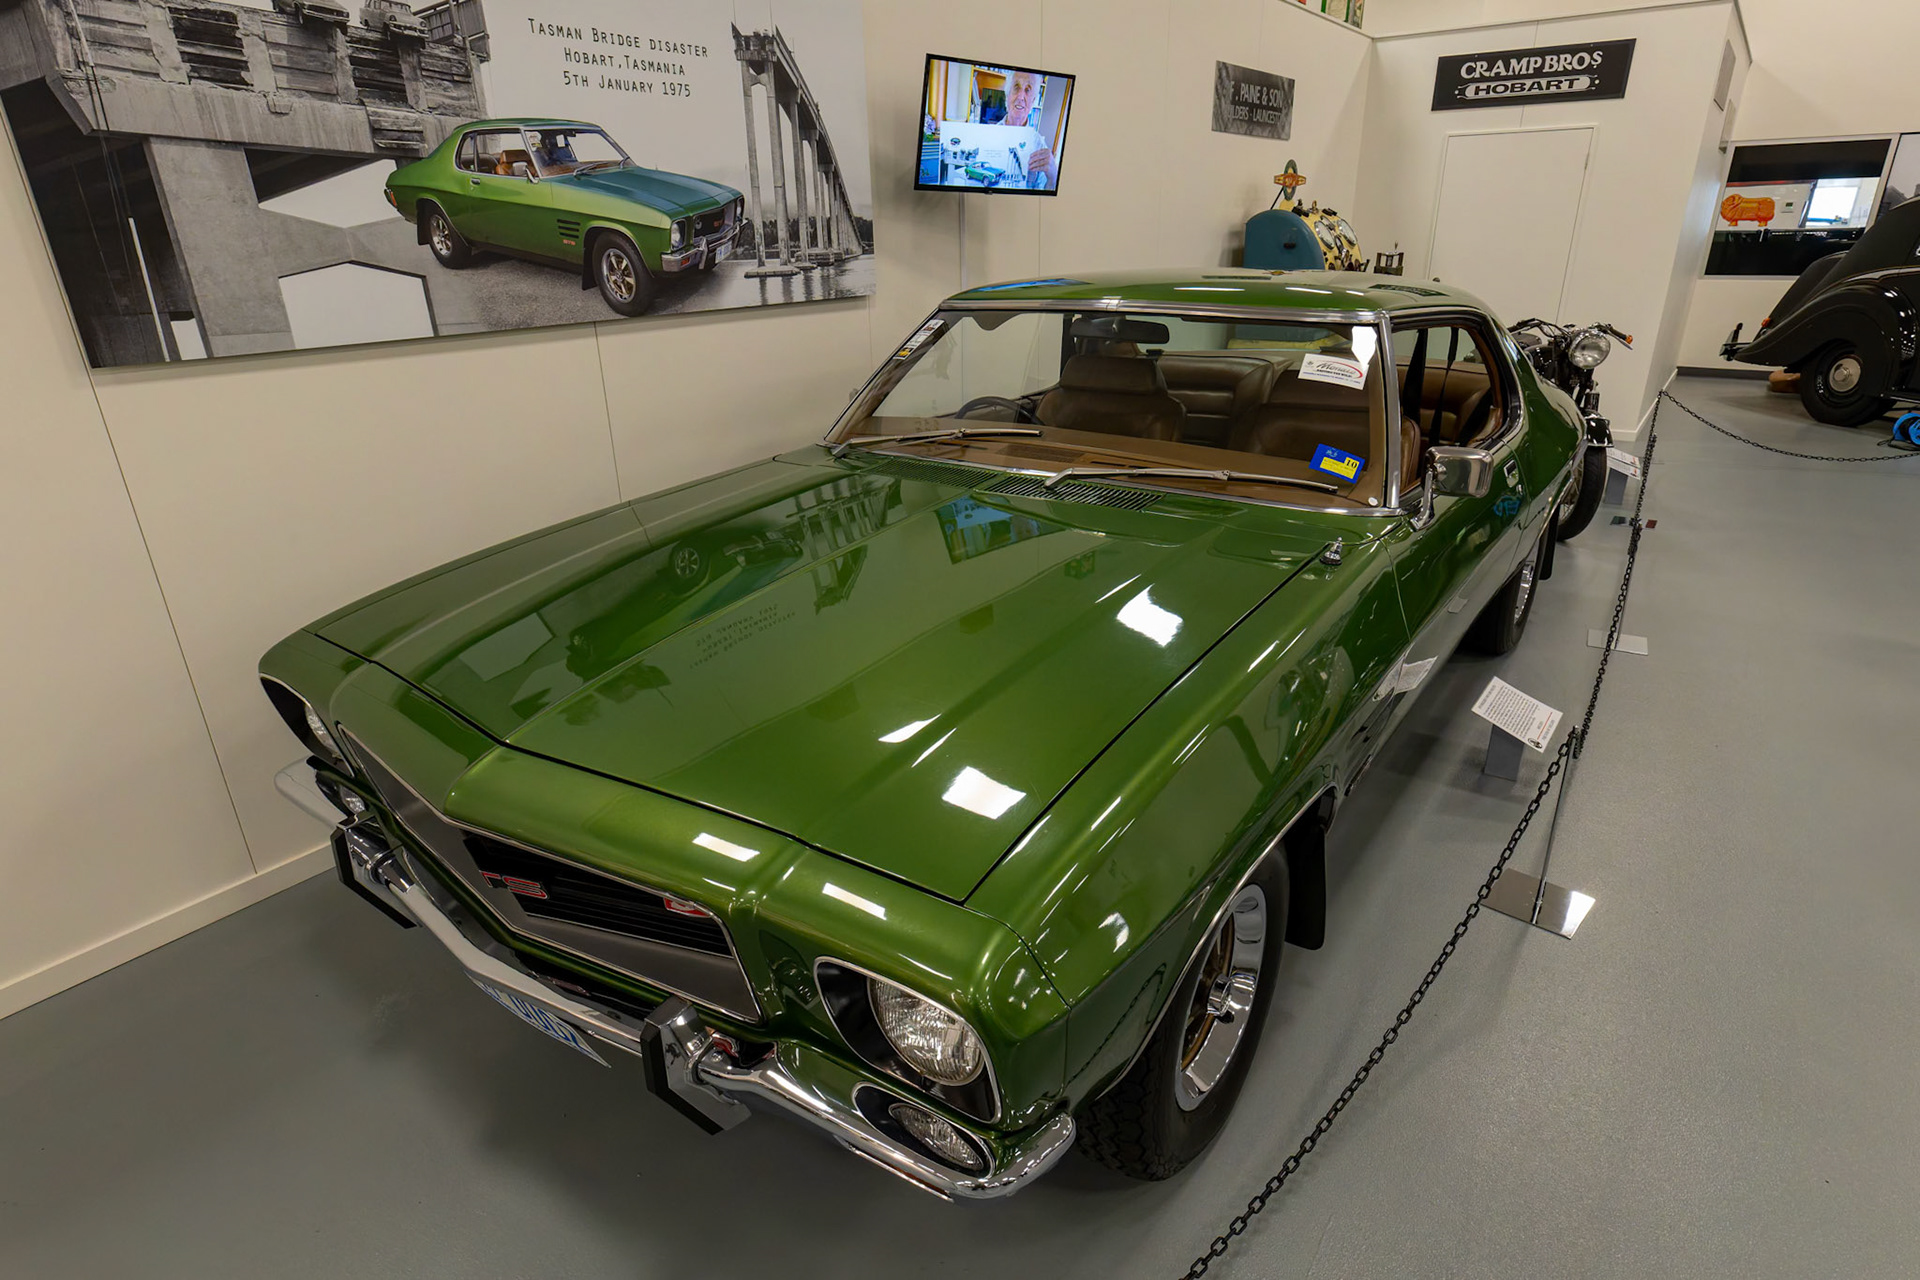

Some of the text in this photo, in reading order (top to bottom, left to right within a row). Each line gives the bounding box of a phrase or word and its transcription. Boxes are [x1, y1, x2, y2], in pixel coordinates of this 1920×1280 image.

[528, 18, 708, 57] TASMAN BRIDGE DISASTER
[1460, 55, 1542, 79] CRAMP
[563, 71, 691, 97] 5TH JANUARY 1975
[1473, 78, 1580, 96] HOBART
[1261, 87, 1268, 105] &
[1346, 459, 1358, 469] 10
